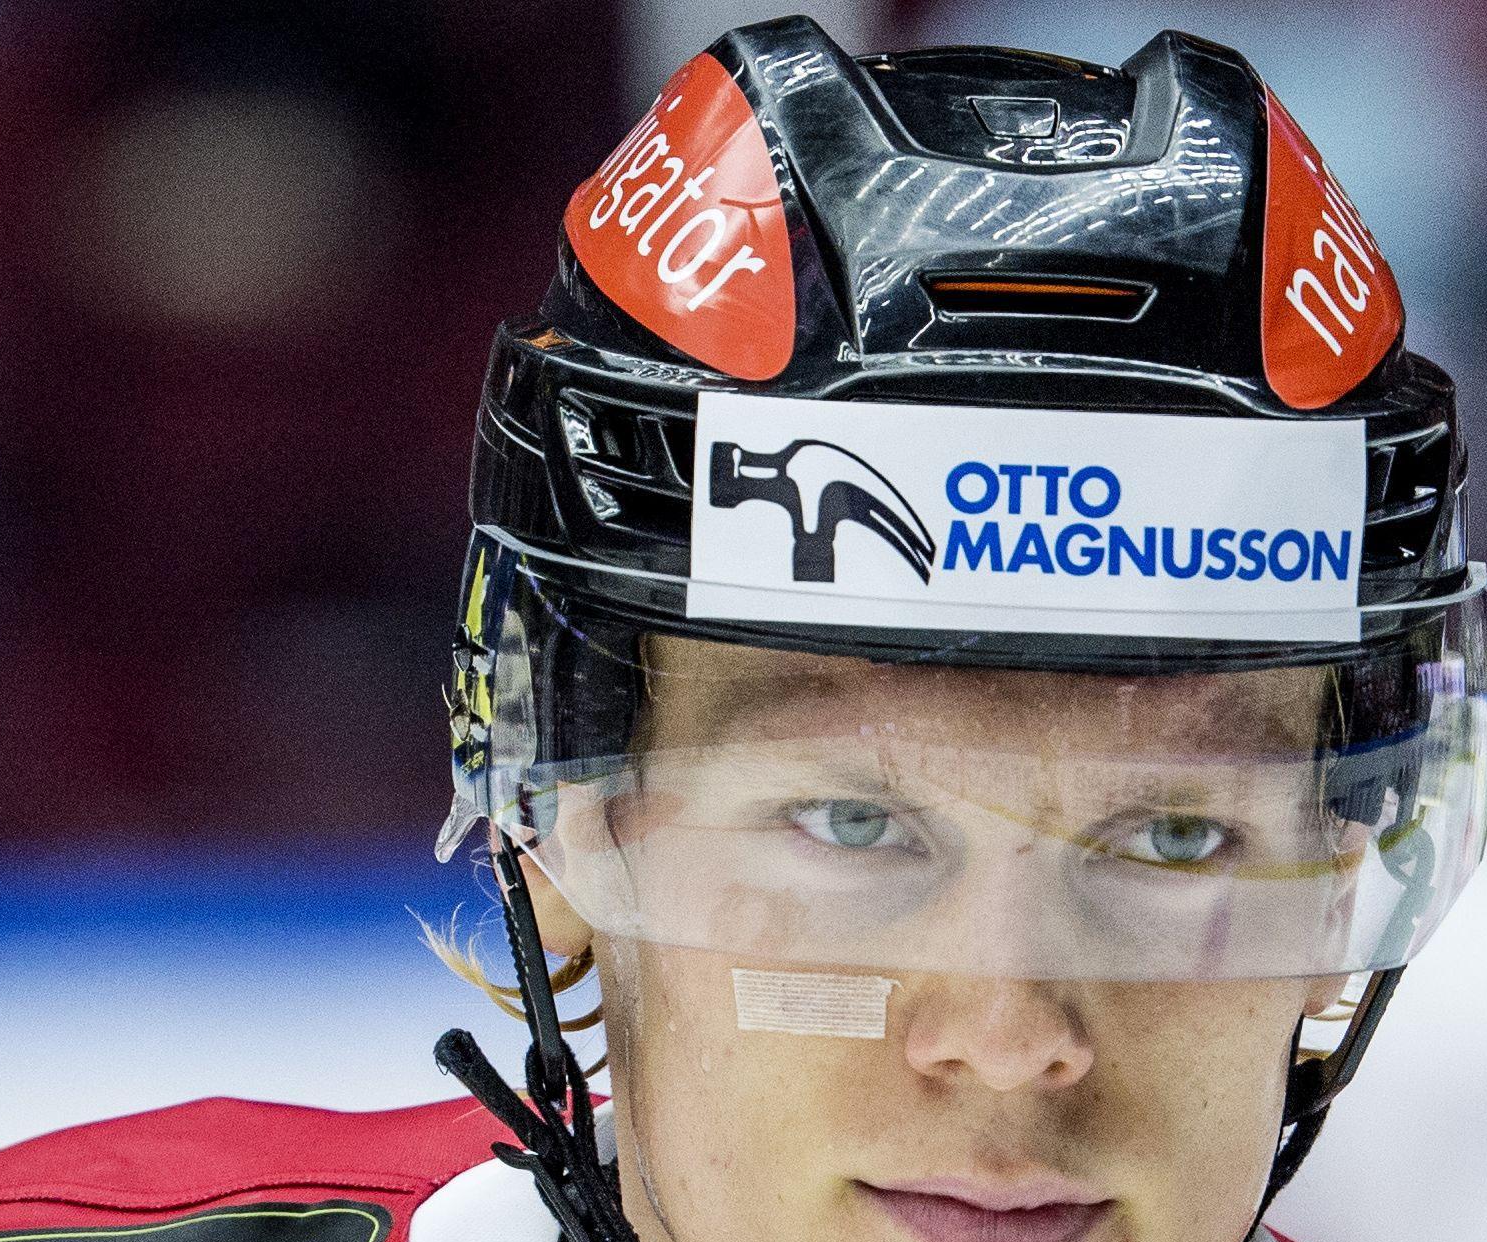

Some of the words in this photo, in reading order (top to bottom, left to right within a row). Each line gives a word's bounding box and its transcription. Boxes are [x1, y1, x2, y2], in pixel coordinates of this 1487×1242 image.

[1285, 155, 1385, 357] navi
[945, 461, 1121, 519] OTTO
[942, 520, 1352, 582] MAGNUSSON
